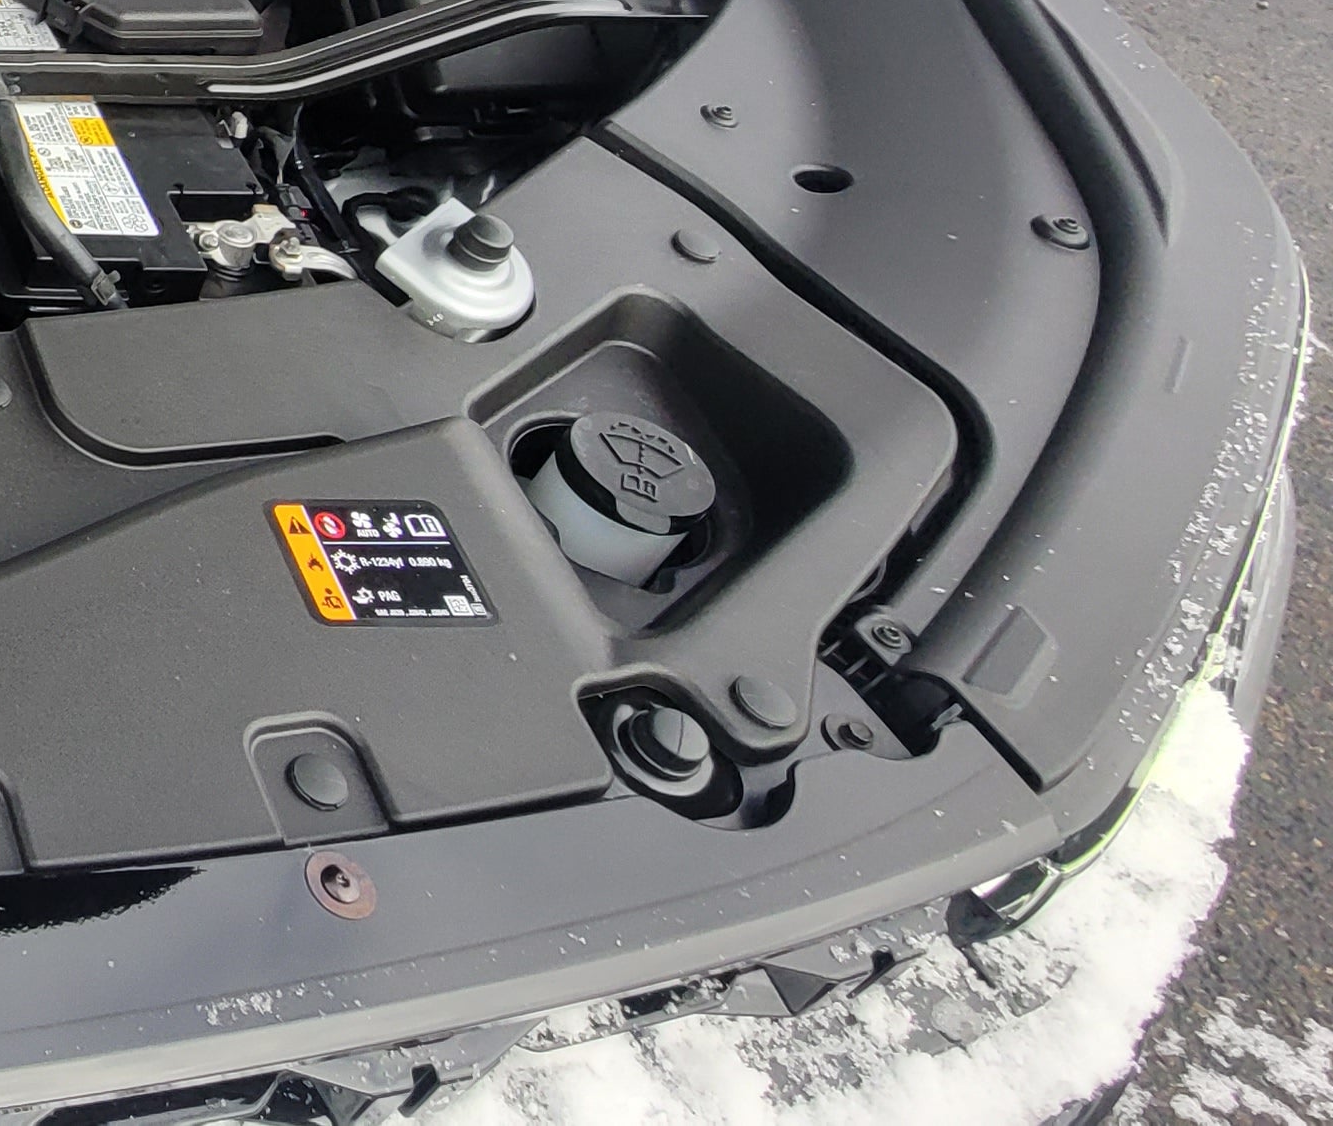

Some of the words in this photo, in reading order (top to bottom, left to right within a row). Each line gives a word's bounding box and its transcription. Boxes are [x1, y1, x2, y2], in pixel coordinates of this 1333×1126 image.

[356, 528, 381, 538] AUTO
[359, 556, 405, 569] R-1234yf
[436, 556, 453, 569] kg
[378, 590, 402, 602] PAG
